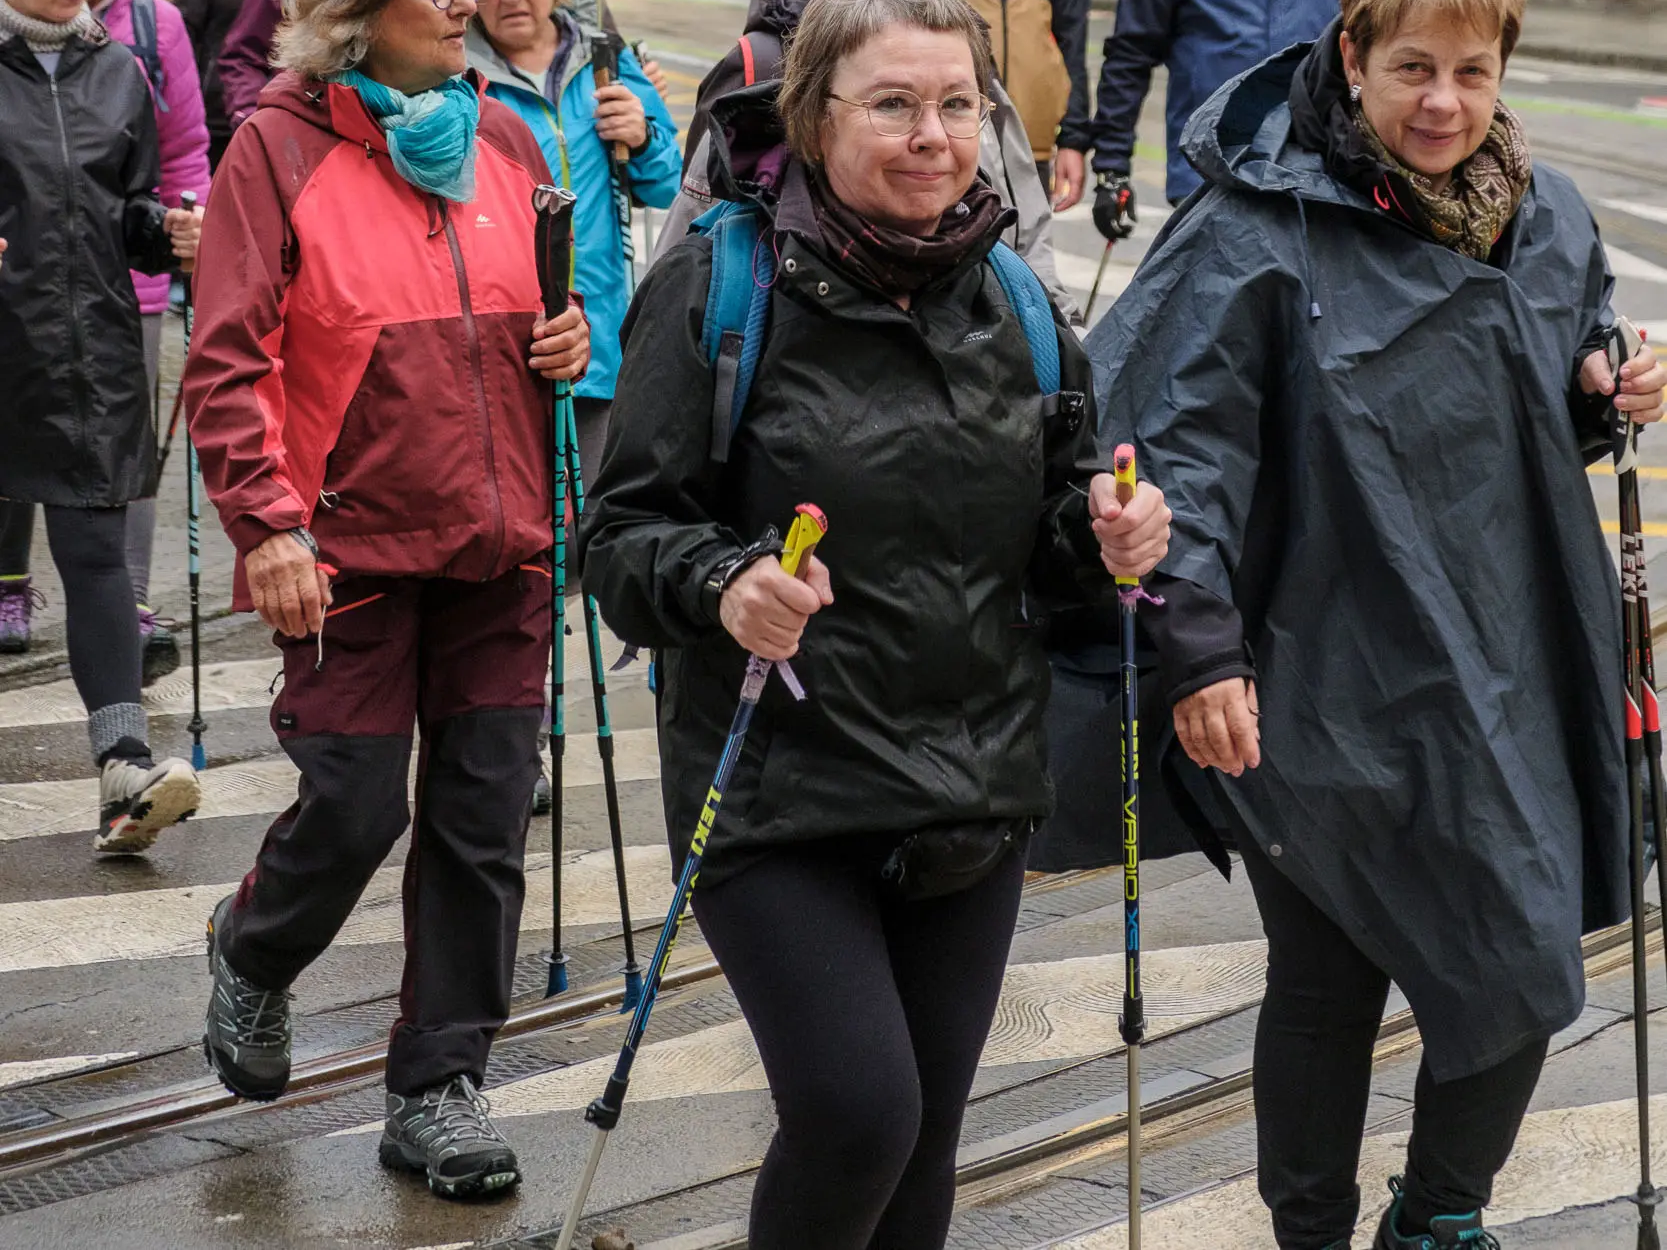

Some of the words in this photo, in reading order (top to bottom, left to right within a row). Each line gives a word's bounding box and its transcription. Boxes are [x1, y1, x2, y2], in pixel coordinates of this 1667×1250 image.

[1622, 533, 1637, 603] LEKI
[1634, 532, 1649, 598] LEKI
[690, 785, 721, 856] LEKI
[1124, 794, 1137, 900] VARIO
[1127, 907, 1138, 950] XS
